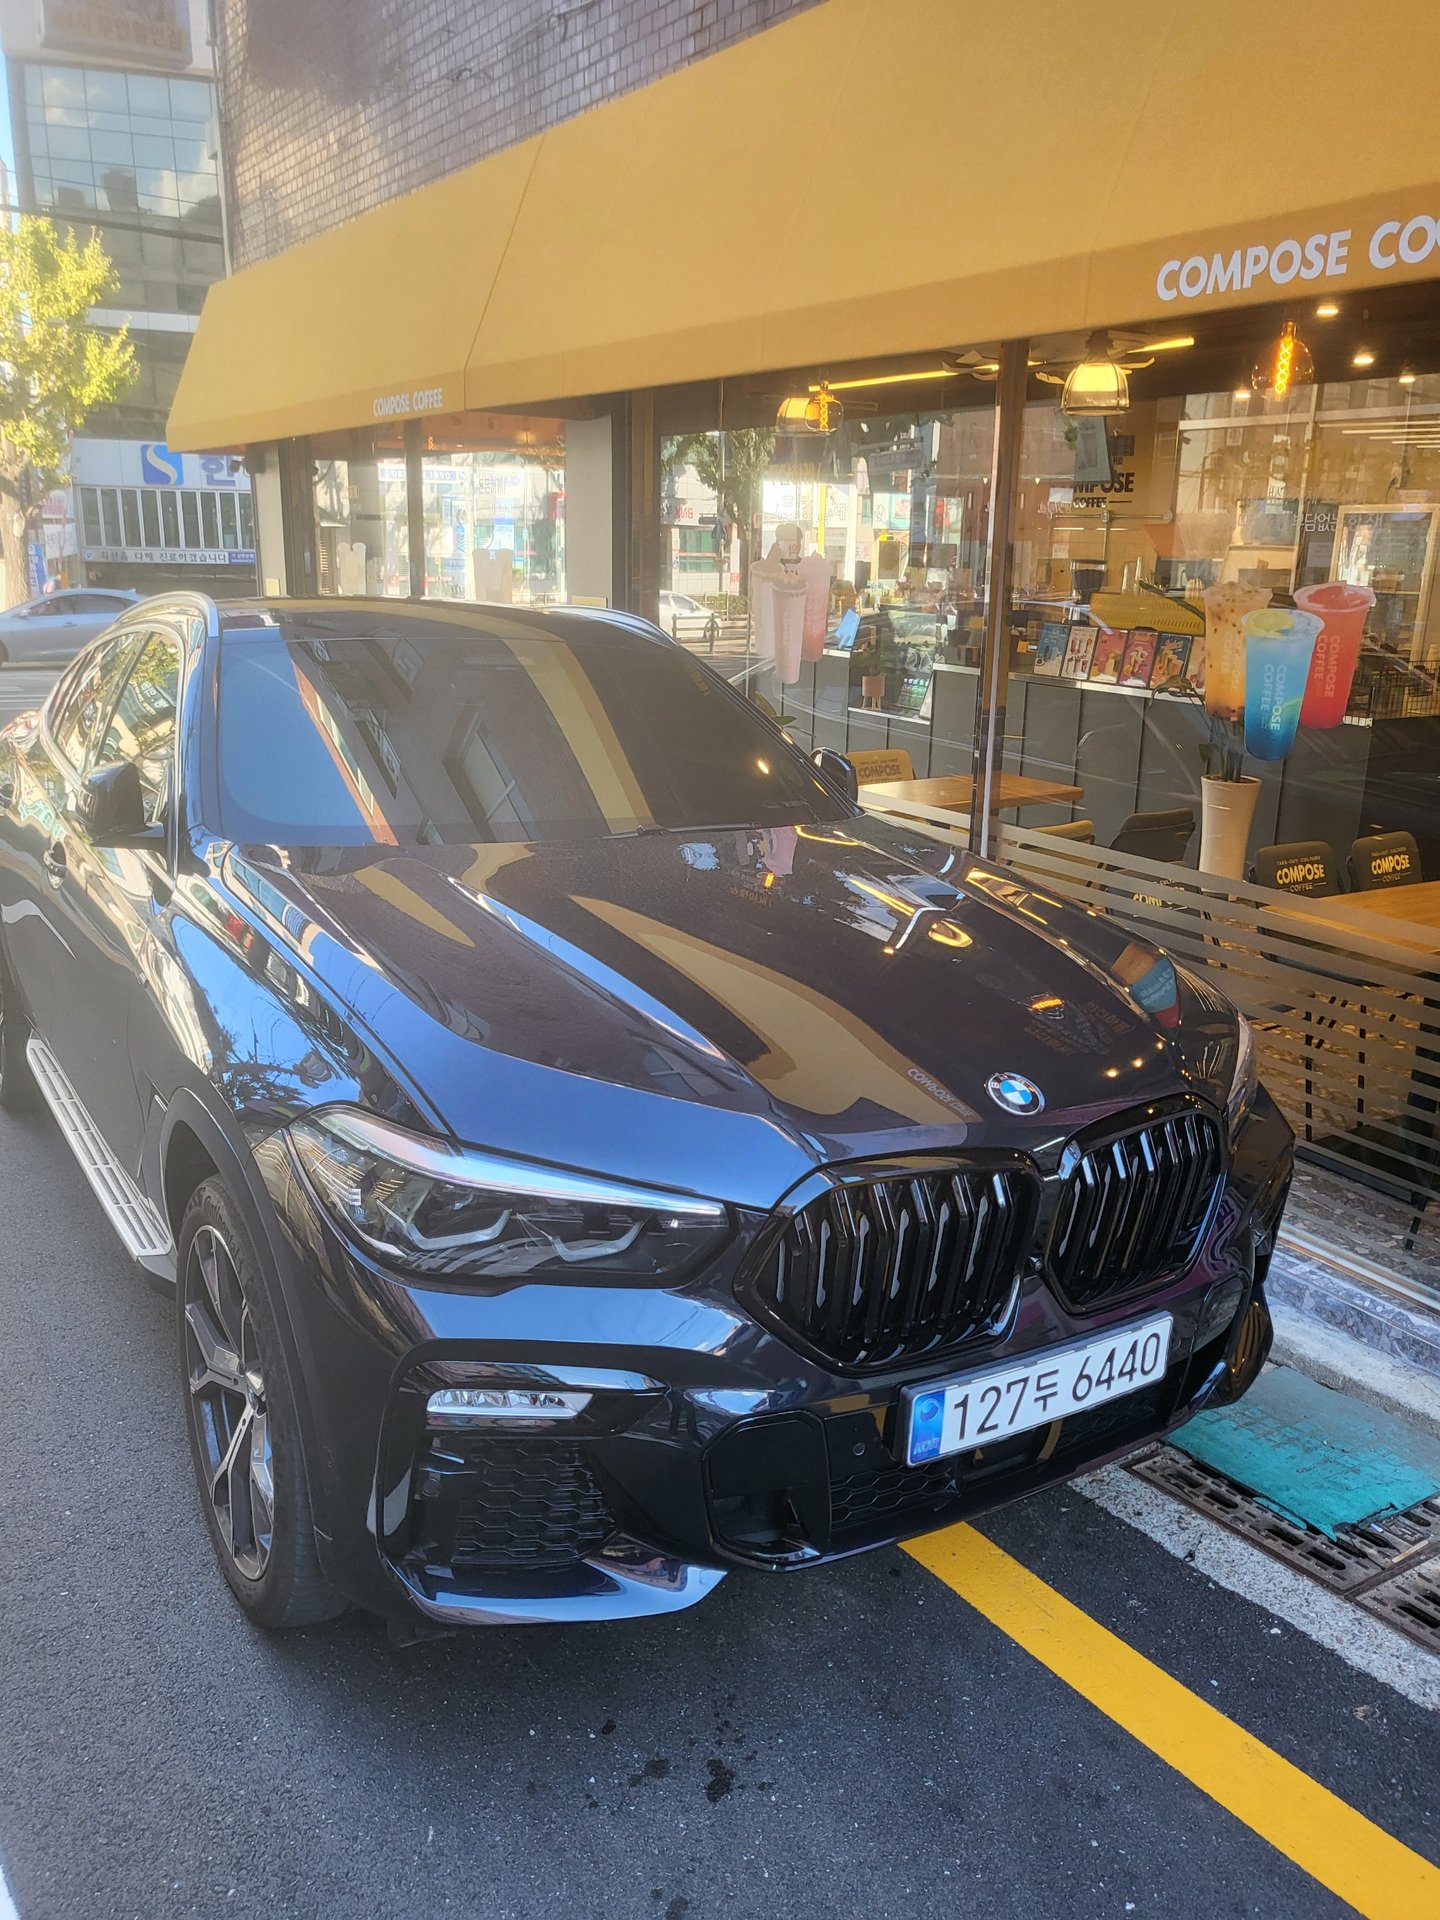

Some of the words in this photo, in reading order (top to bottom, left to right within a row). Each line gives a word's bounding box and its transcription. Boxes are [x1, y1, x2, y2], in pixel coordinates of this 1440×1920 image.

[1156, 229, 1352, 302] COMPOSE
[1368, 215, 1440, 270] CO
[373, 393, 410, 417] COMPOSE
[413, 388, 443, 411] COFFEE
[1314, 634, 1327, 680] COFFEE
[1325, 634, 1340, 698] COMPOSE
[1260, 663, 1274, 711] COFFEE
[1270, 664, 1287, 731] COMPOSE
[859, 764, 902, 778] COMPOSE
[1276, 863, 1325, 885] COMPOSE
[1290, 882, 1313, 892] COFFEE
[1371, 854, 1410, 875] COMPOSE
[953, 1368, 1060, 1441] 127두
[1071, 1332, 1162, 1403] 6440
